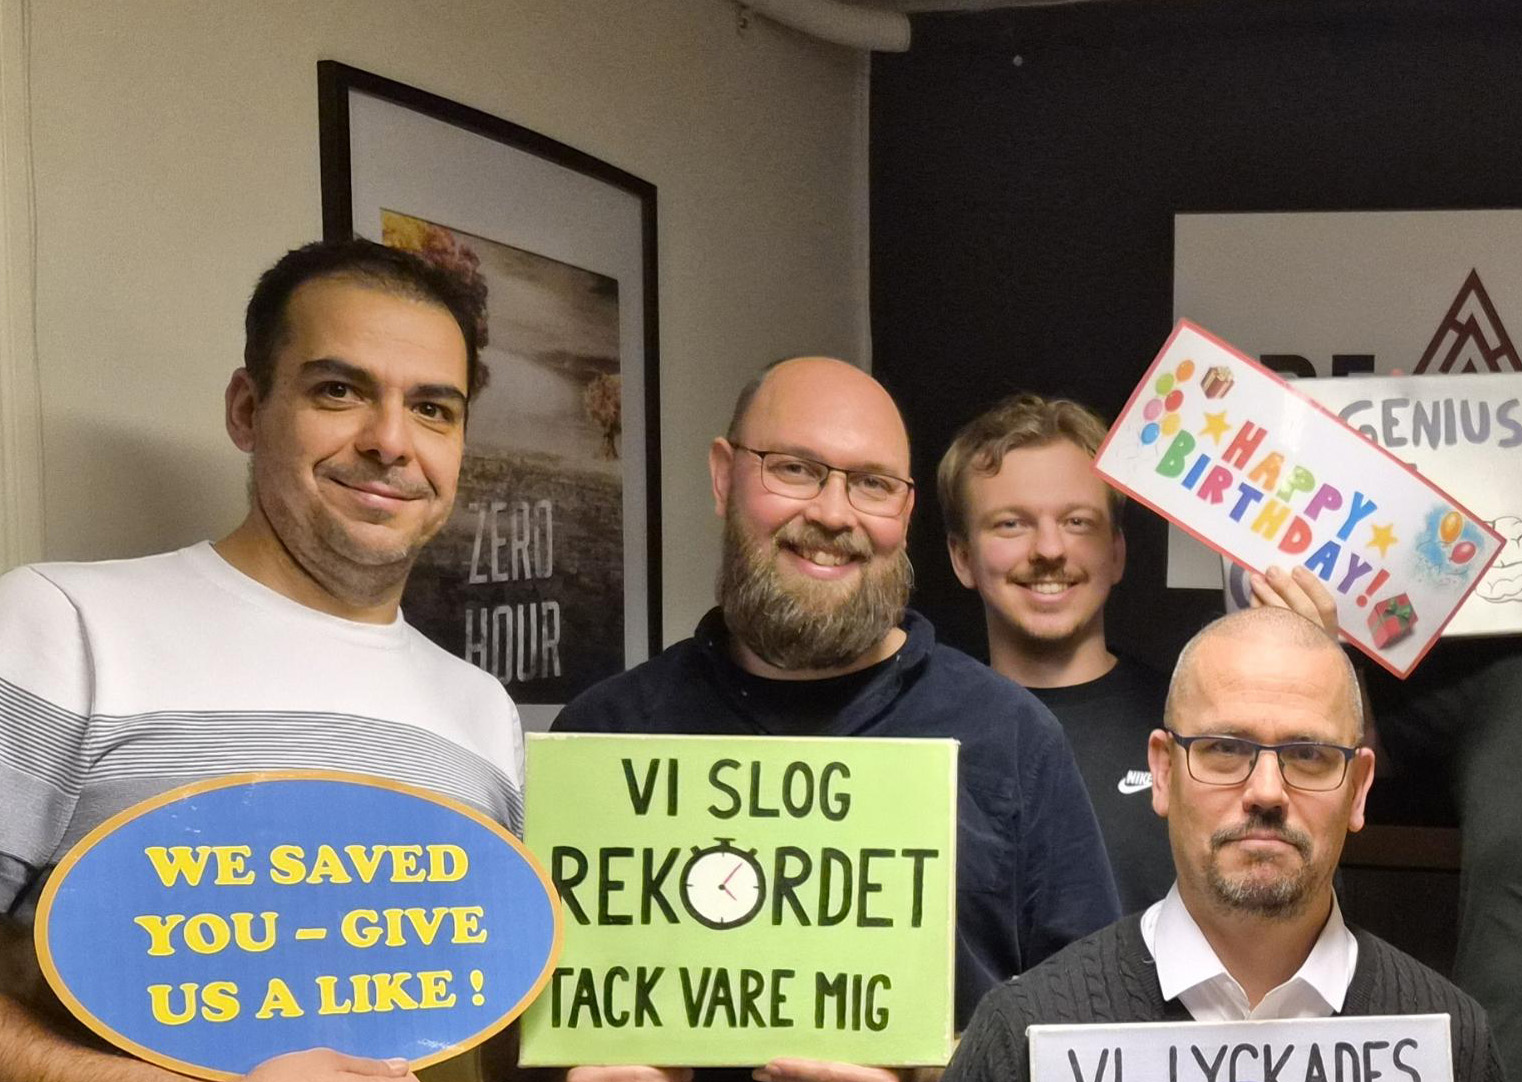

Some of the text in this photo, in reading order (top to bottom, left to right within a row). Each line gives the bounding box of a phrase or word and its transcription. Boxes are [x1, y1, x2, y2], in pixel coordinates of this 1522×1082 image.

[1221, 420, 1377, 542] HAPPY
[469, 500, 553, 584] ZERO
[1155, 429, 1390, 607] BIRTHDAY!
[465, 601, 561, 686] HOUR
[621, 758, 851, 821] VI SLOG
[1126, 769, 1153, 785] NIKE
[145, 844, 469, 887] WE SAVED
[551, 838, 939, 930] REKORDET
[134, 911, 279, 956] YOU
[341, 906, 488, 948] GIVE
[147, 980, 240, 1025] US
[255, 977, 304, 1020] A
[551, 966, 892, 1032] TACK VARE MIG
